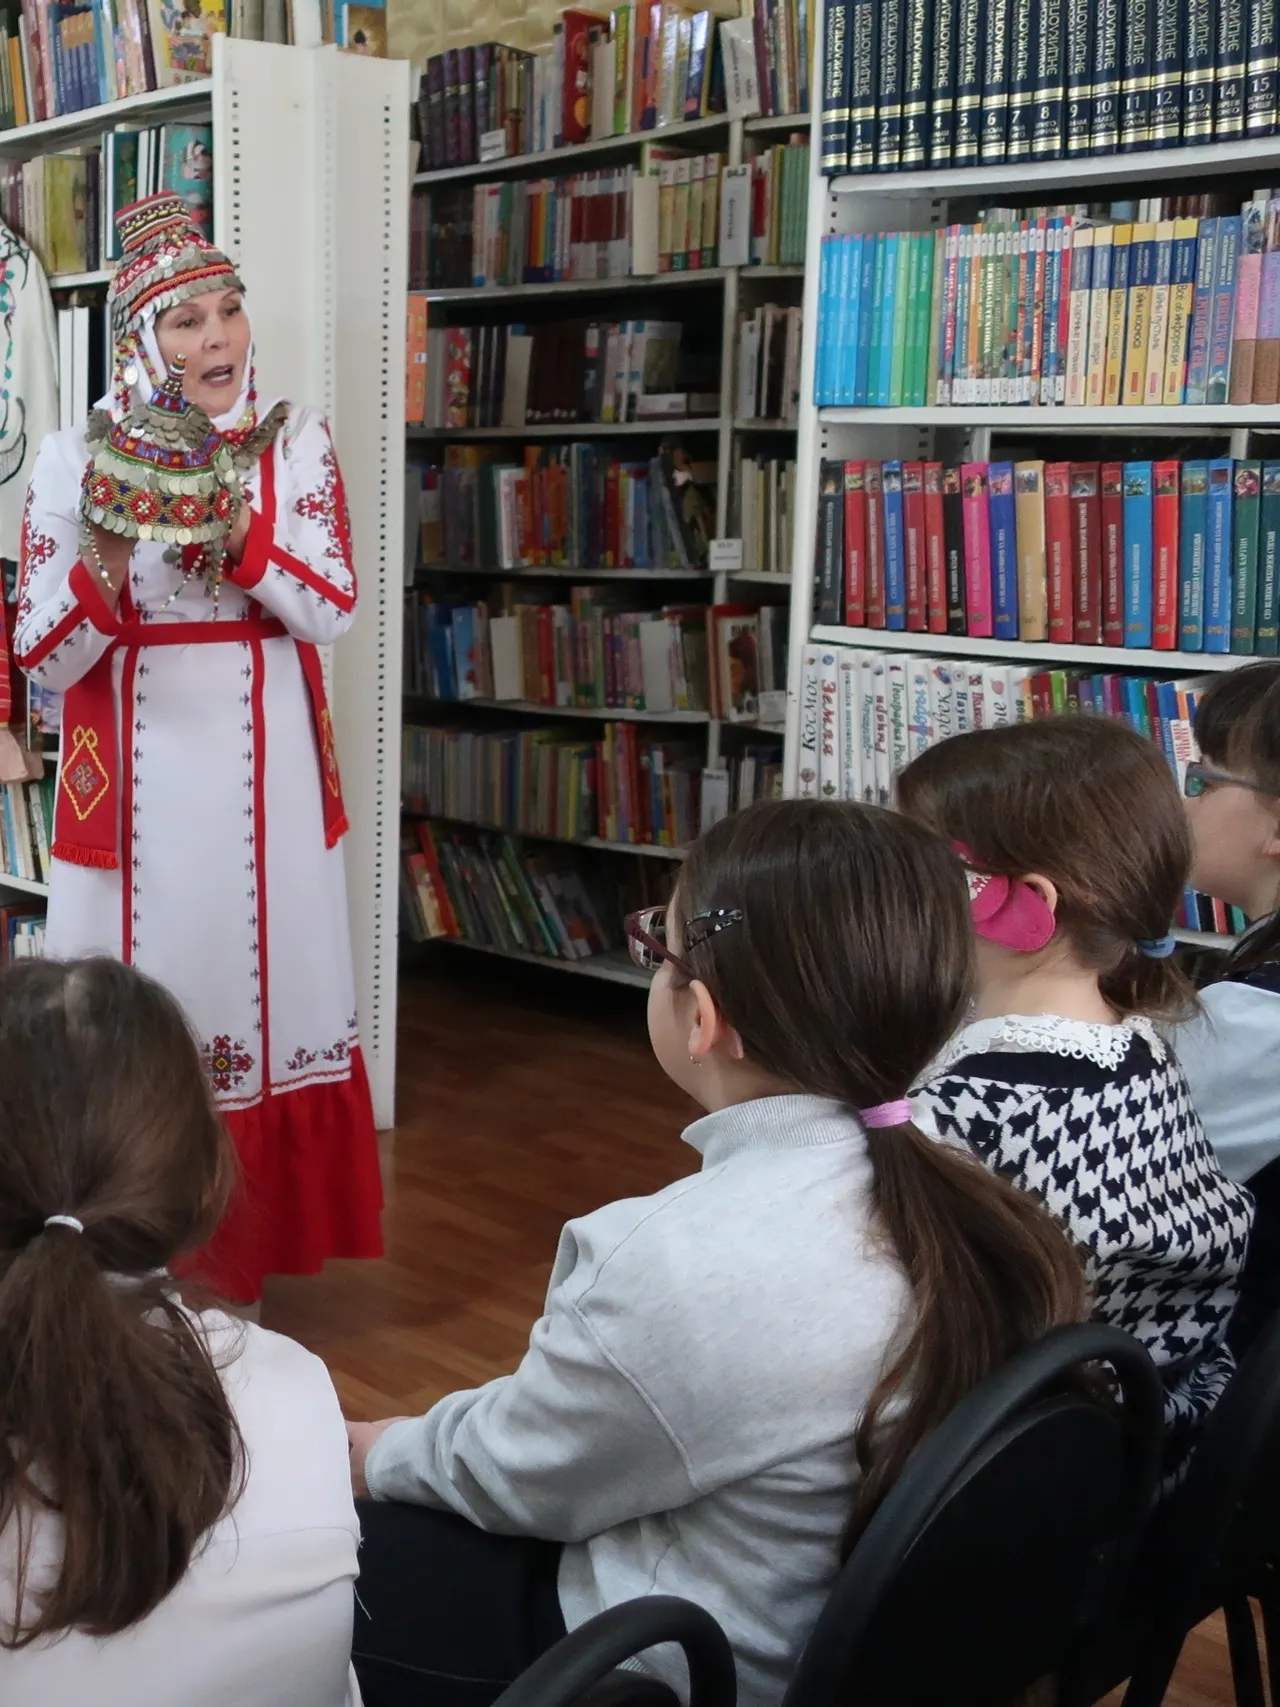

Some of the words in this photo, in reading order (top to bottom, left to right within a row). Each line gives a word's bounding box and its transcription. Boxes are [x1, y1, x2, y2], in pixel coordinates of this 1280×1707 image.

[832, 6, 846, 98] ЭНЦИКЛОПЕДИЯ
[859, 2, 872, 96] ЭНЦИКЛОПЕДИЯ
[885, 0, 898, 94] ЭНЦИКЛОПЕДИЯ
[1156, 90, 1173, 106] 12
[1188, 88, 1205, 103] 13
[1219, 83, 1237, 99] 14
[1251, 76, 1270, 93] 15
[1040, 105, 1050, 120] 8
[1070, 104, 1078, 118] 9
[1096, 99, 1112, 114] 10
[1126, 95, 1140, 110] 11
[855, 124, 862, 136] 1
[880, 122, 889, 135] 2
[907, 119, 915, 132] 3
[934, 116, 942, 128] 4
[960, 112, 968, 126] 5
[987, 111, 996, 126] 6
[1012, 110, 1021, 124] 7
[1112, 290, 1124, 321] Тайны
[1136, 286, 1148, 313] Тайны
[1155, 286, 1168, 314] Тайны
[1174, 302, 1184, 312] об
[1073, 291, 1086, 338] Загадочные
[1194, 295, 1210, 346] ЖИВОТНЫХ
[1215, 292, 1231, 342] РАСТЕНИЙ
[983, 308, 992, 354] ТЕХНИКА
[1110, 324, 1120, 360] океана
[1132, 314, 1144, 349] космоса
[1150, 315, 1164, 350] пустынь
[1170, 314, 1184, 367] информации
[1072, 340, 1080, 374] растения
[1090, 342, 1100, 366] звери
[1239, 538, 1248, 565] КАРТИН
[1183, 580, 1191, 605] ВЕЛИКИХ
[1238, 566, 1247, 599] ВЕЛИКИХ
[1264, 583, 1272, 608] ВЕЛИКИХ
[1158, 605, 1166, 616] СТО
[1237, 600, 1246, 615] СТО
[1263, 608, 1271, 620] СТО
[844, 671, 854, 707] искусство
[802, 674, 818, 752] Космос
[822, 678, 836, 756] Земля
[874, 694, 888, 754] Рыцари
[890, 682, 906, 741] География
[932, 688, 952, 738] овек
[955, 691, 968, 730] Наука
[844, 710, 854, 770] Изобразительное
